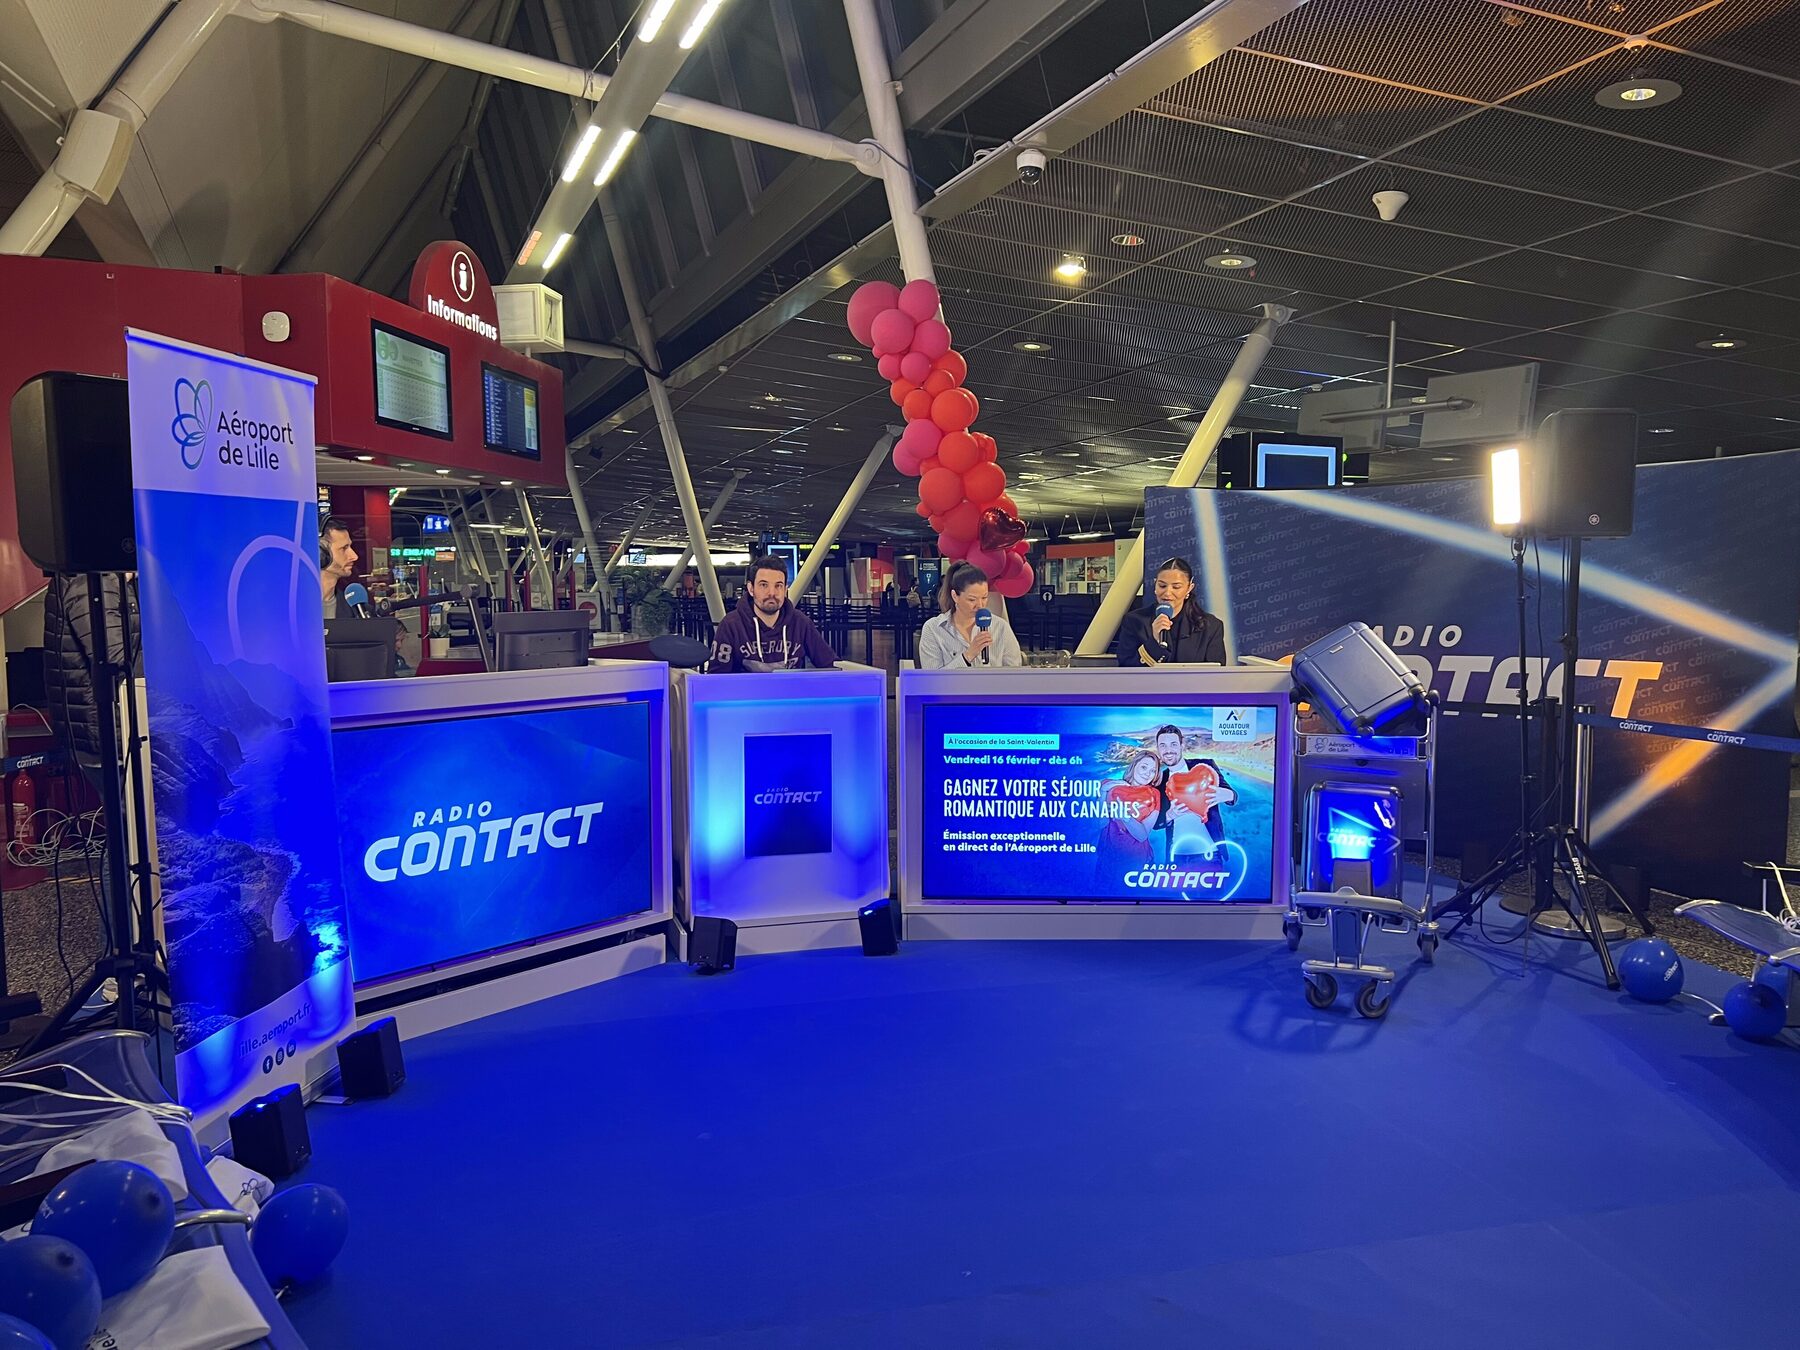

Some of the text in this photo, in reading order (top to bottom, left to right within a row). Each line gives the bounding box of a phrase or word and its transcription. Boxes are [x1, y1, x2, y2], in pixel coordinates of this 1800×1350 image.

[428, 294, 498, 341] Informations
[217, 410, 293, 446] Aéroport
[219, 440, 279, 470] de Lille
[1371, 625, 1462, 648] DIO
[1619, 721, 1653, 733] CONTACT
[948, 736, 954, 744] À
[1706, 732, 1746, 745] CONTACT
[16, 756, 44, 769] CONTACT
[943, 755, 1083, 765] Vendredi 16 février dès 6h
[943, 776, 1101, 798] GAGNEZ VOTRE SÉJOUR
[754, 791, 822, 805] CONTACT
[412, 800, 492, 828] RADIO
[943, 800, 1140, 819] ROMANTIQUE AUX CANARIES
[363, 802, 604, 882] CONTACT
[943, 829, 1066, 842] Émission exceptionnelle
[1318, 832, 1378, 848] CONTAC
[957, 842, 989, 851] direct
[990, 843, 1003, 851] de
[1005, 843, 1058, 853] l'Aéroport
[1059, 844, 1073, 852] de
[1075, 844, 1097, 852] Lille
[1123, 871, 1231, 888] CONTACT
